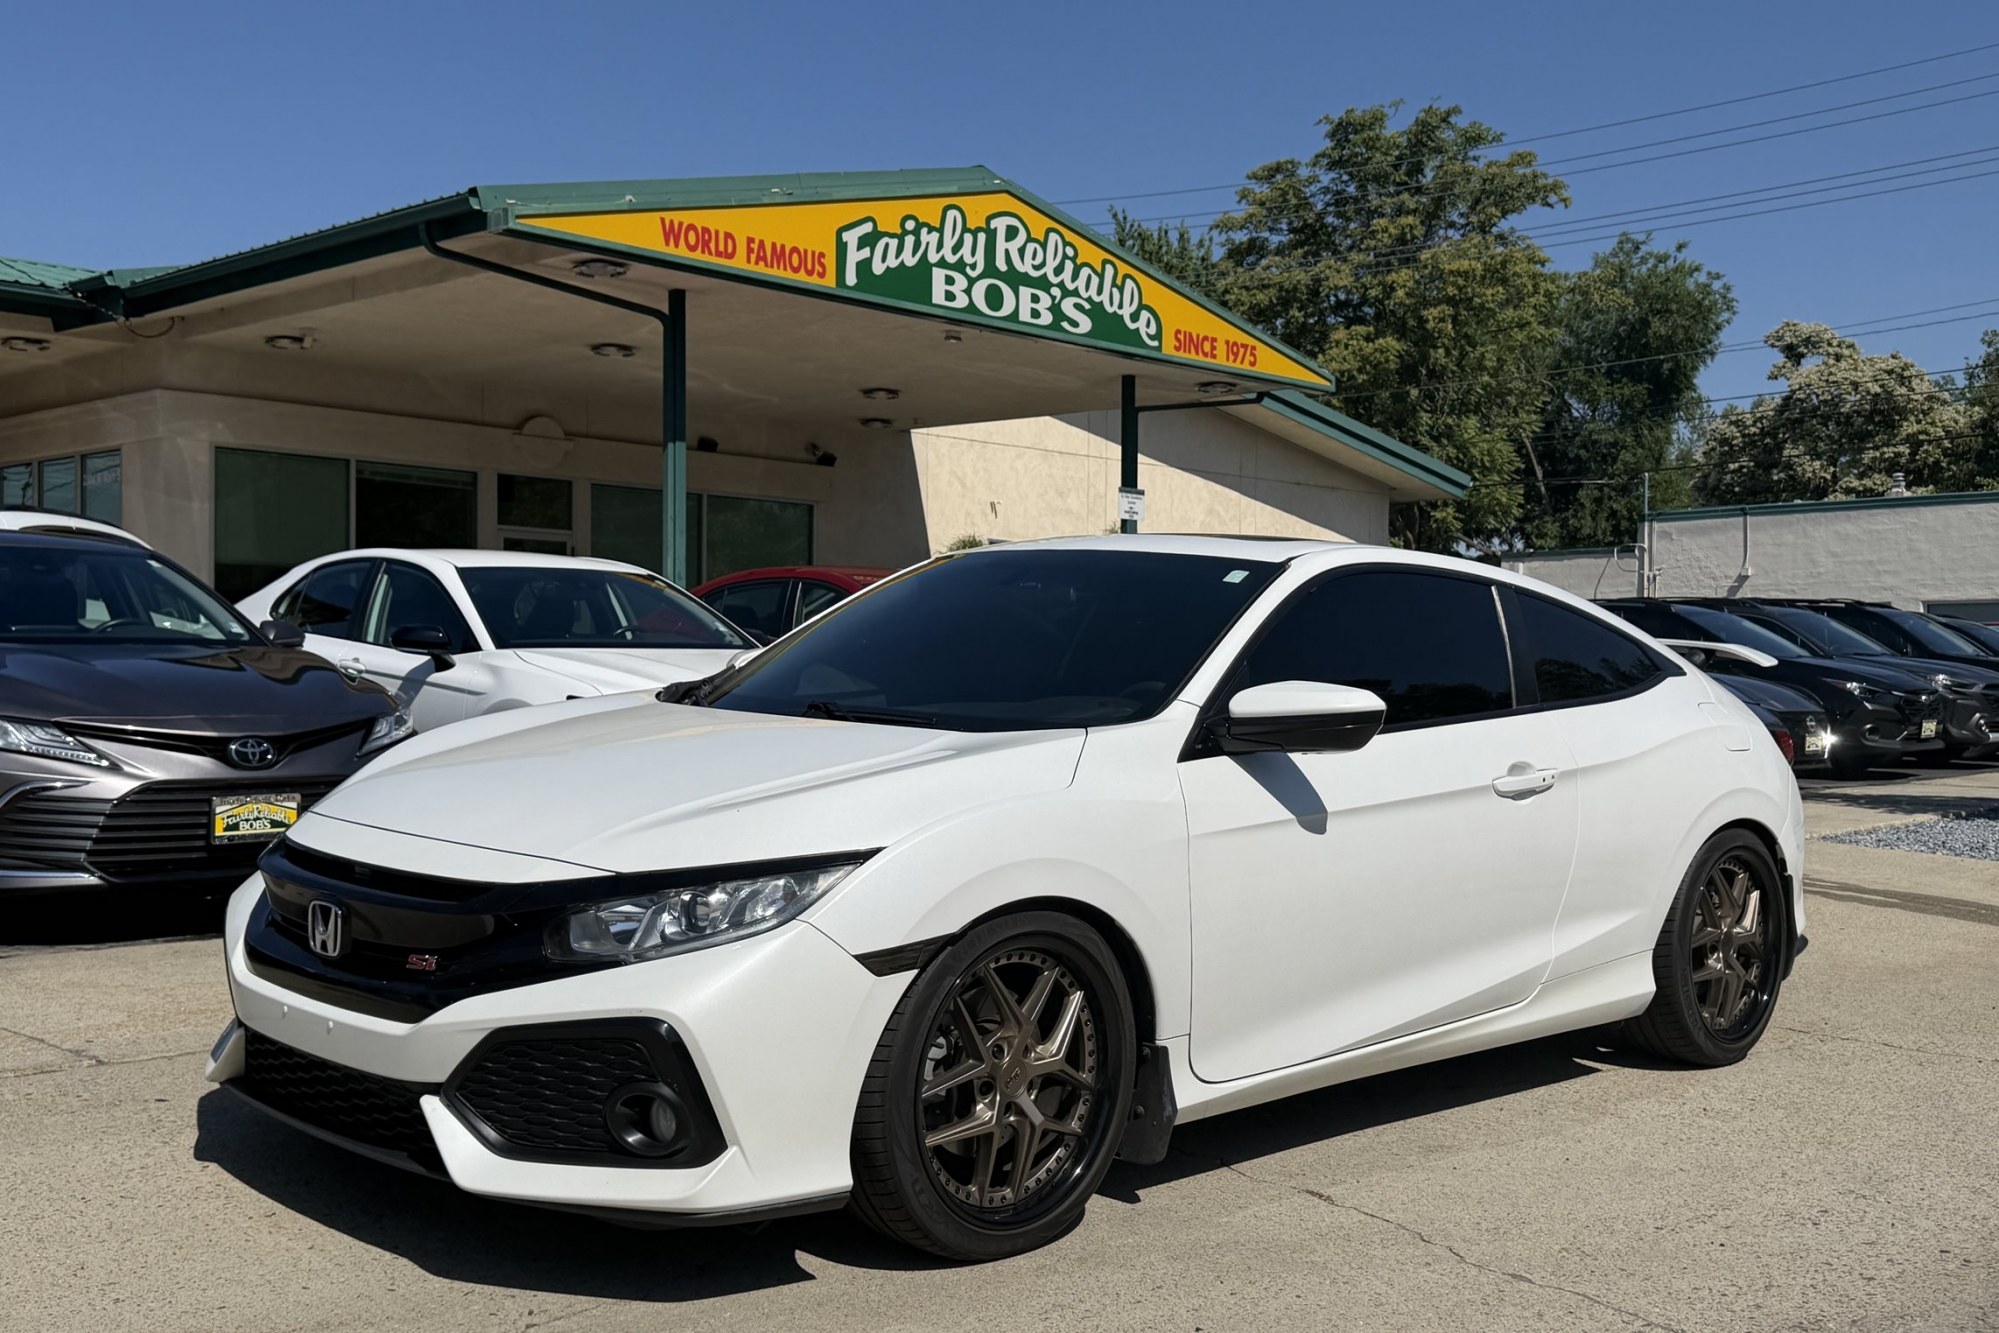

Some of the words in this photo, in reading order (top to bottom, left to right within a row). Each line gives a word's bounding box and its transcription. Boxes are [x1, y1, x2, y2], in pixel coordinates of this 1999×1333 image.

[660, 216, 737, 260] WORLD
[746, 235, 827, 279] FAMOUS
[841, 208, 986, 287] Fairly
[989, 216, 1159, 347] Reliable
[931, 266, 1093, 334] BOB'S
[1173, 328, 1217, 360] SINCE
[1224, 339, 1257, 367] 1975
[240, 818, 271, 830] BOB'S
